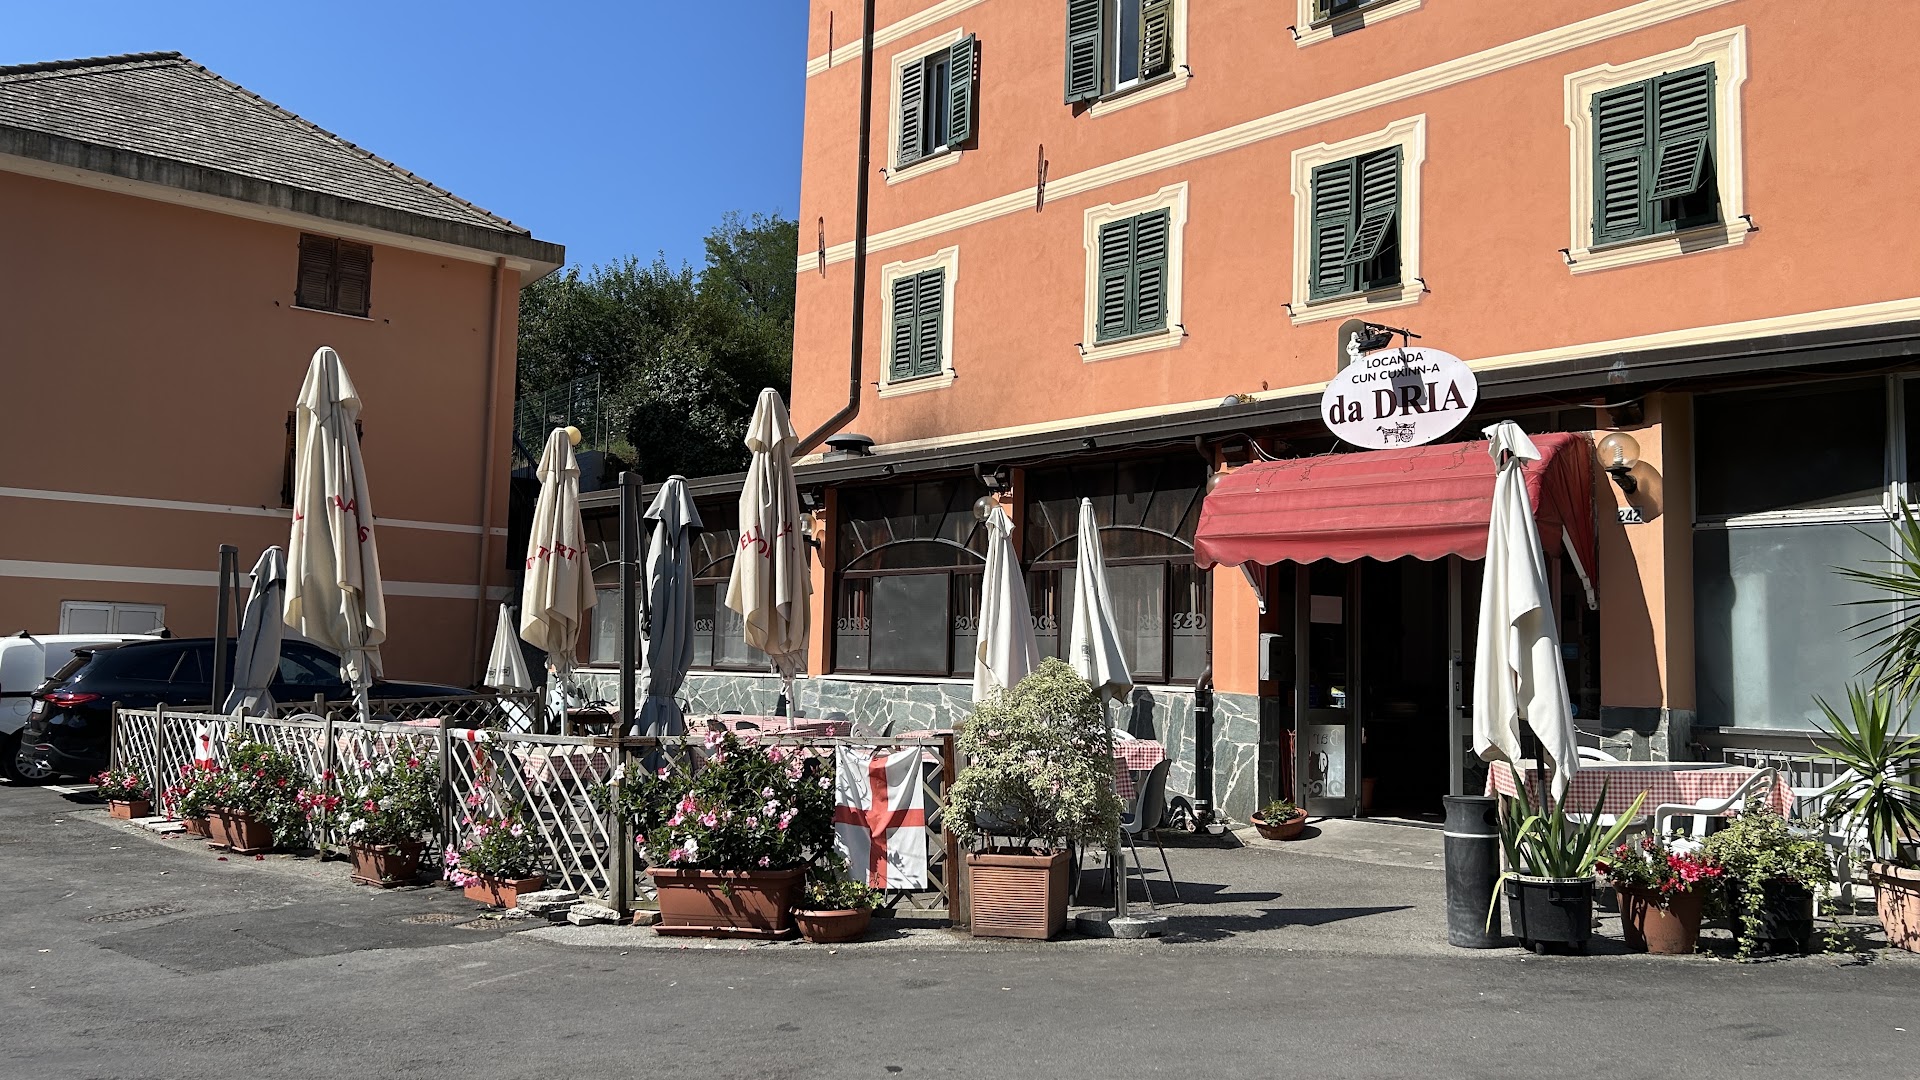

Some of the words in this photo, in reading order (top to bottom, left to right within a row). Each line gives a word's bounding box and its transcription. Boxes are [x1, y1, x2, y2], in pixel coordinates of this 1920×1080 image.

[1366, 352, 1424, 369] LOCANDA
[1351, 372, 1377, 384] CUN
[1379, 363, 1440, 379] CUXINN-A
[1329, 395, 1364, 425] da
[1372, 379, 1469, 420] DRIA
[1617, 509, 1642, 522] 242
